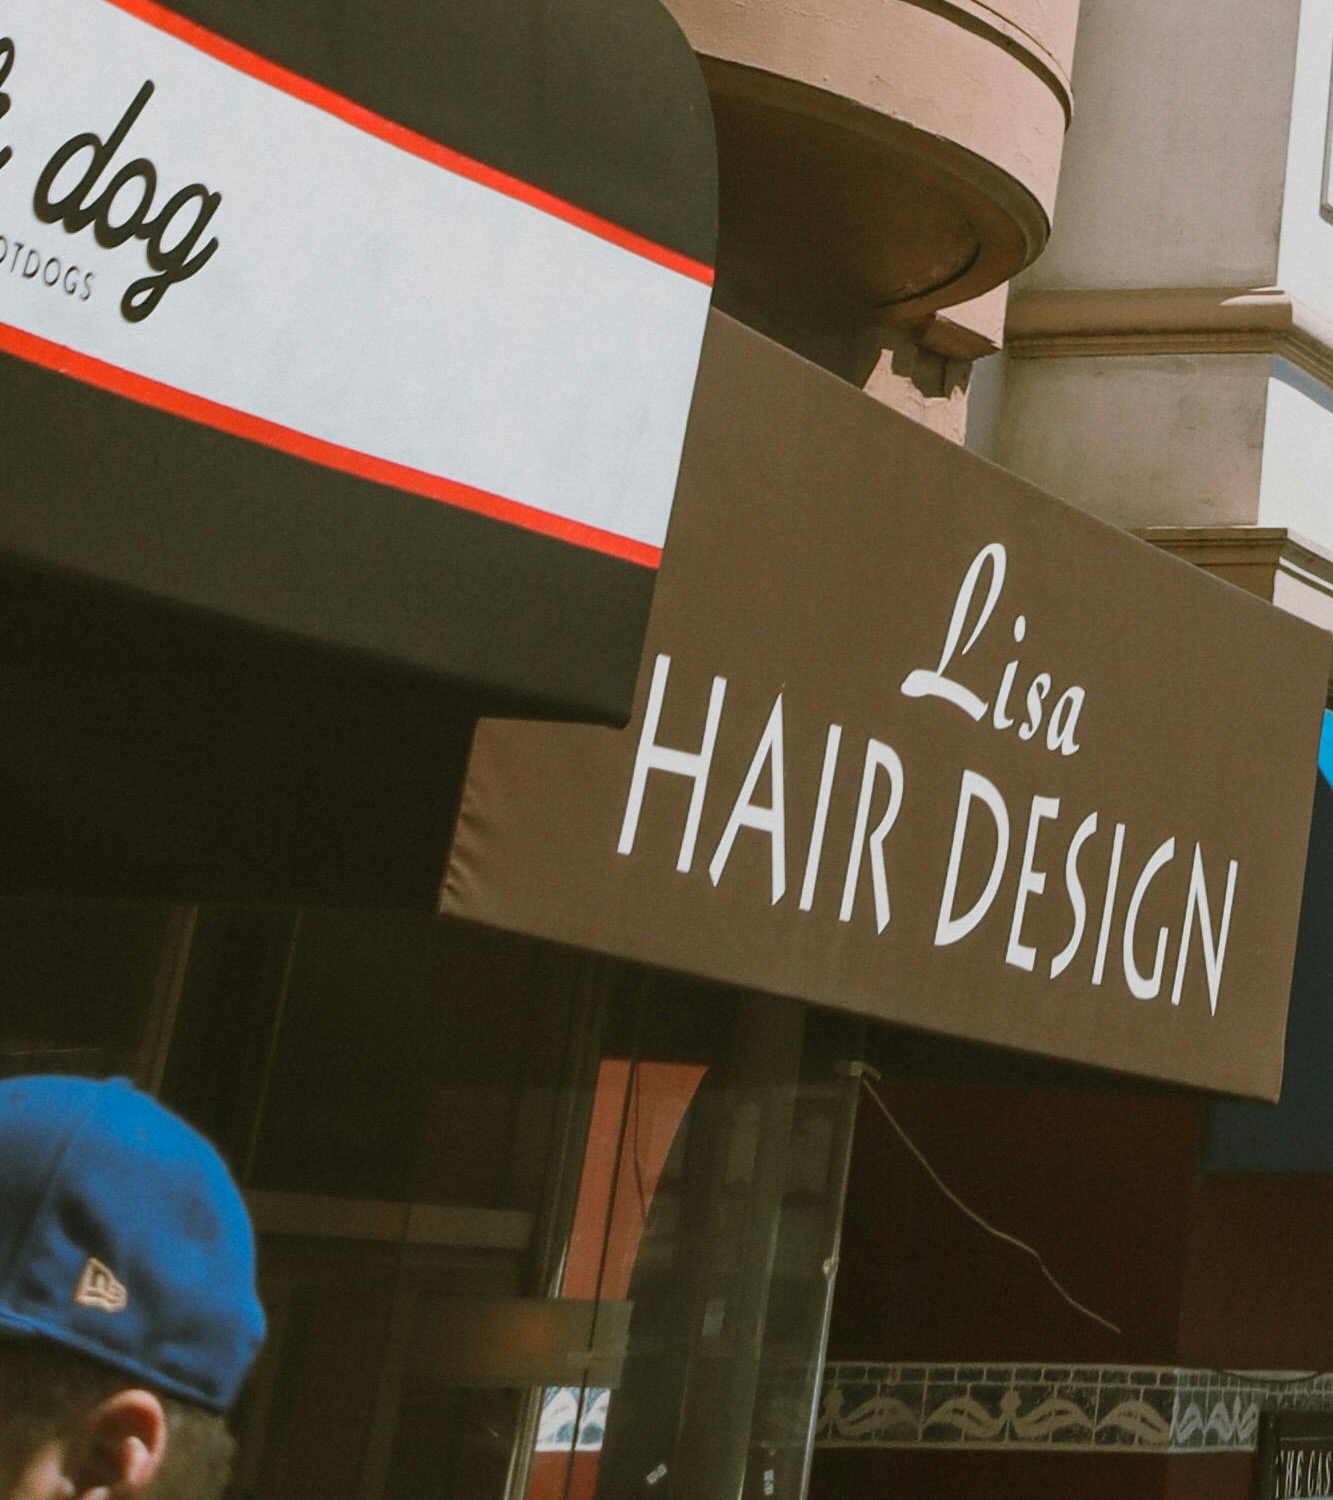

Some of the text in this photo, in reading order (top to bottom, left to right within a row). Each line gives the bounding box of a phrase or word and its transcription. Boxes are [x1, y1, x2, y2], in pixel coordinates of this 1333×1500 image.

[33, 79, 222, 323] dog
[901, 542, 1085, 756] Lisa
[617, 652, 1238, 1017] HAIR DESIGN
